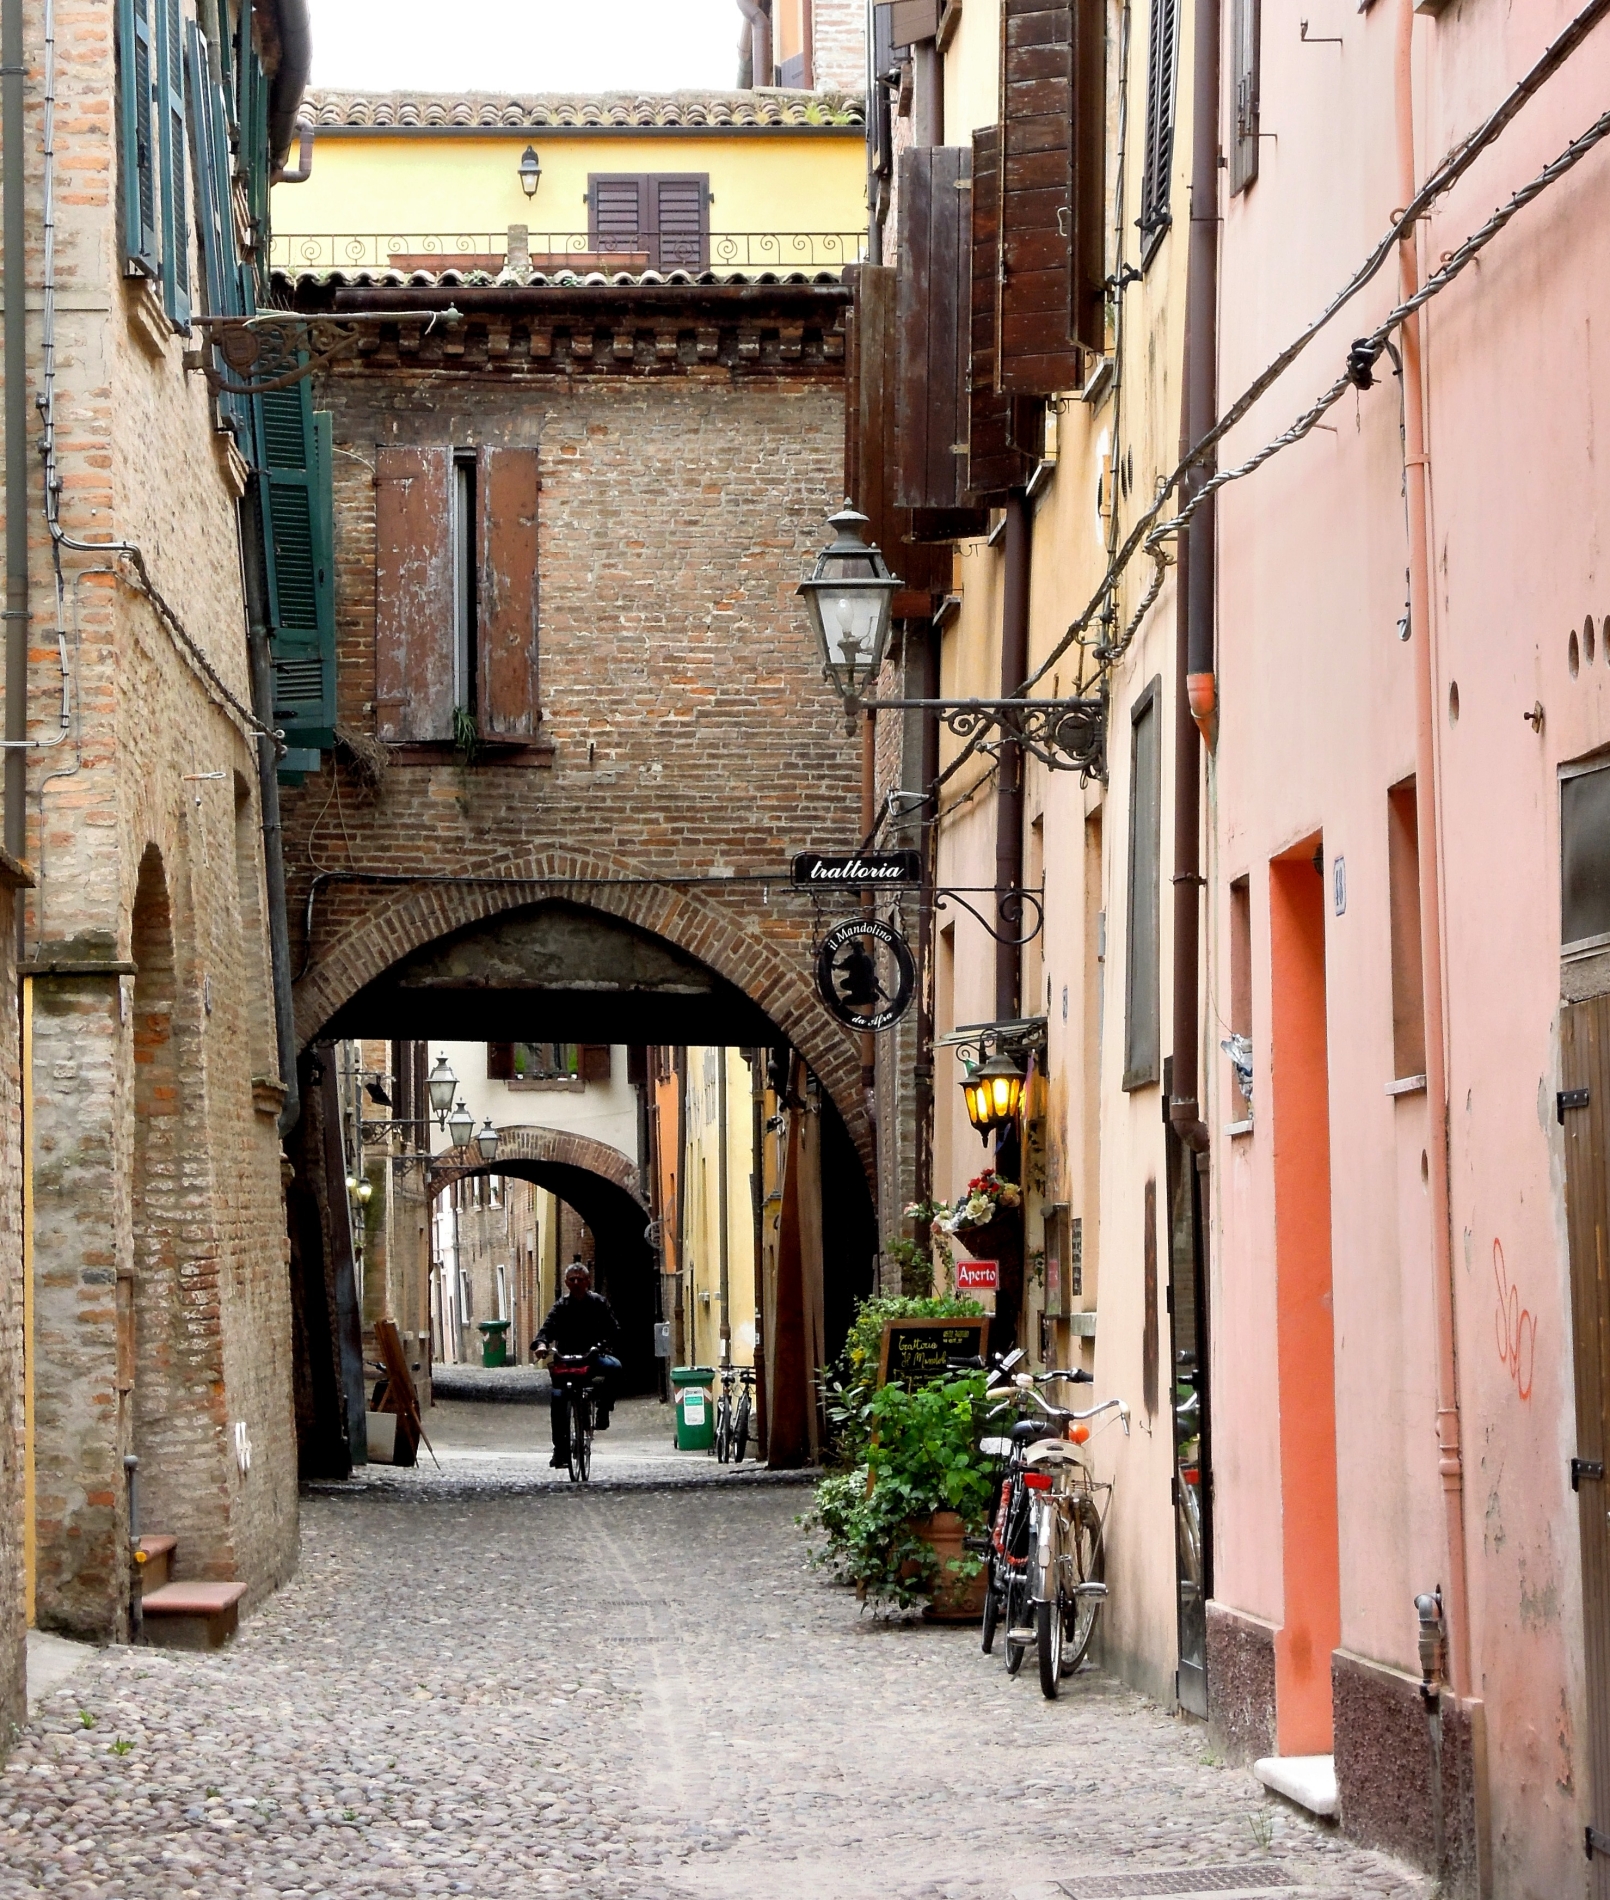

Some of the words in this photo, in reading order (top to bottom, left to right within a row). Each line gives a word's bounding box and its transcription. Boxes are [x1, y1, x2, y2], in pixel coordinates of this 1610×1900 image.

[810, 860, 904, 879] trattoria
[828, 940, 839, 951] il
[836, 922, 892, 943] Mandolino
[851, 1015, 867, 1025] da
[959, 1265, 996, 1285] Aperto
